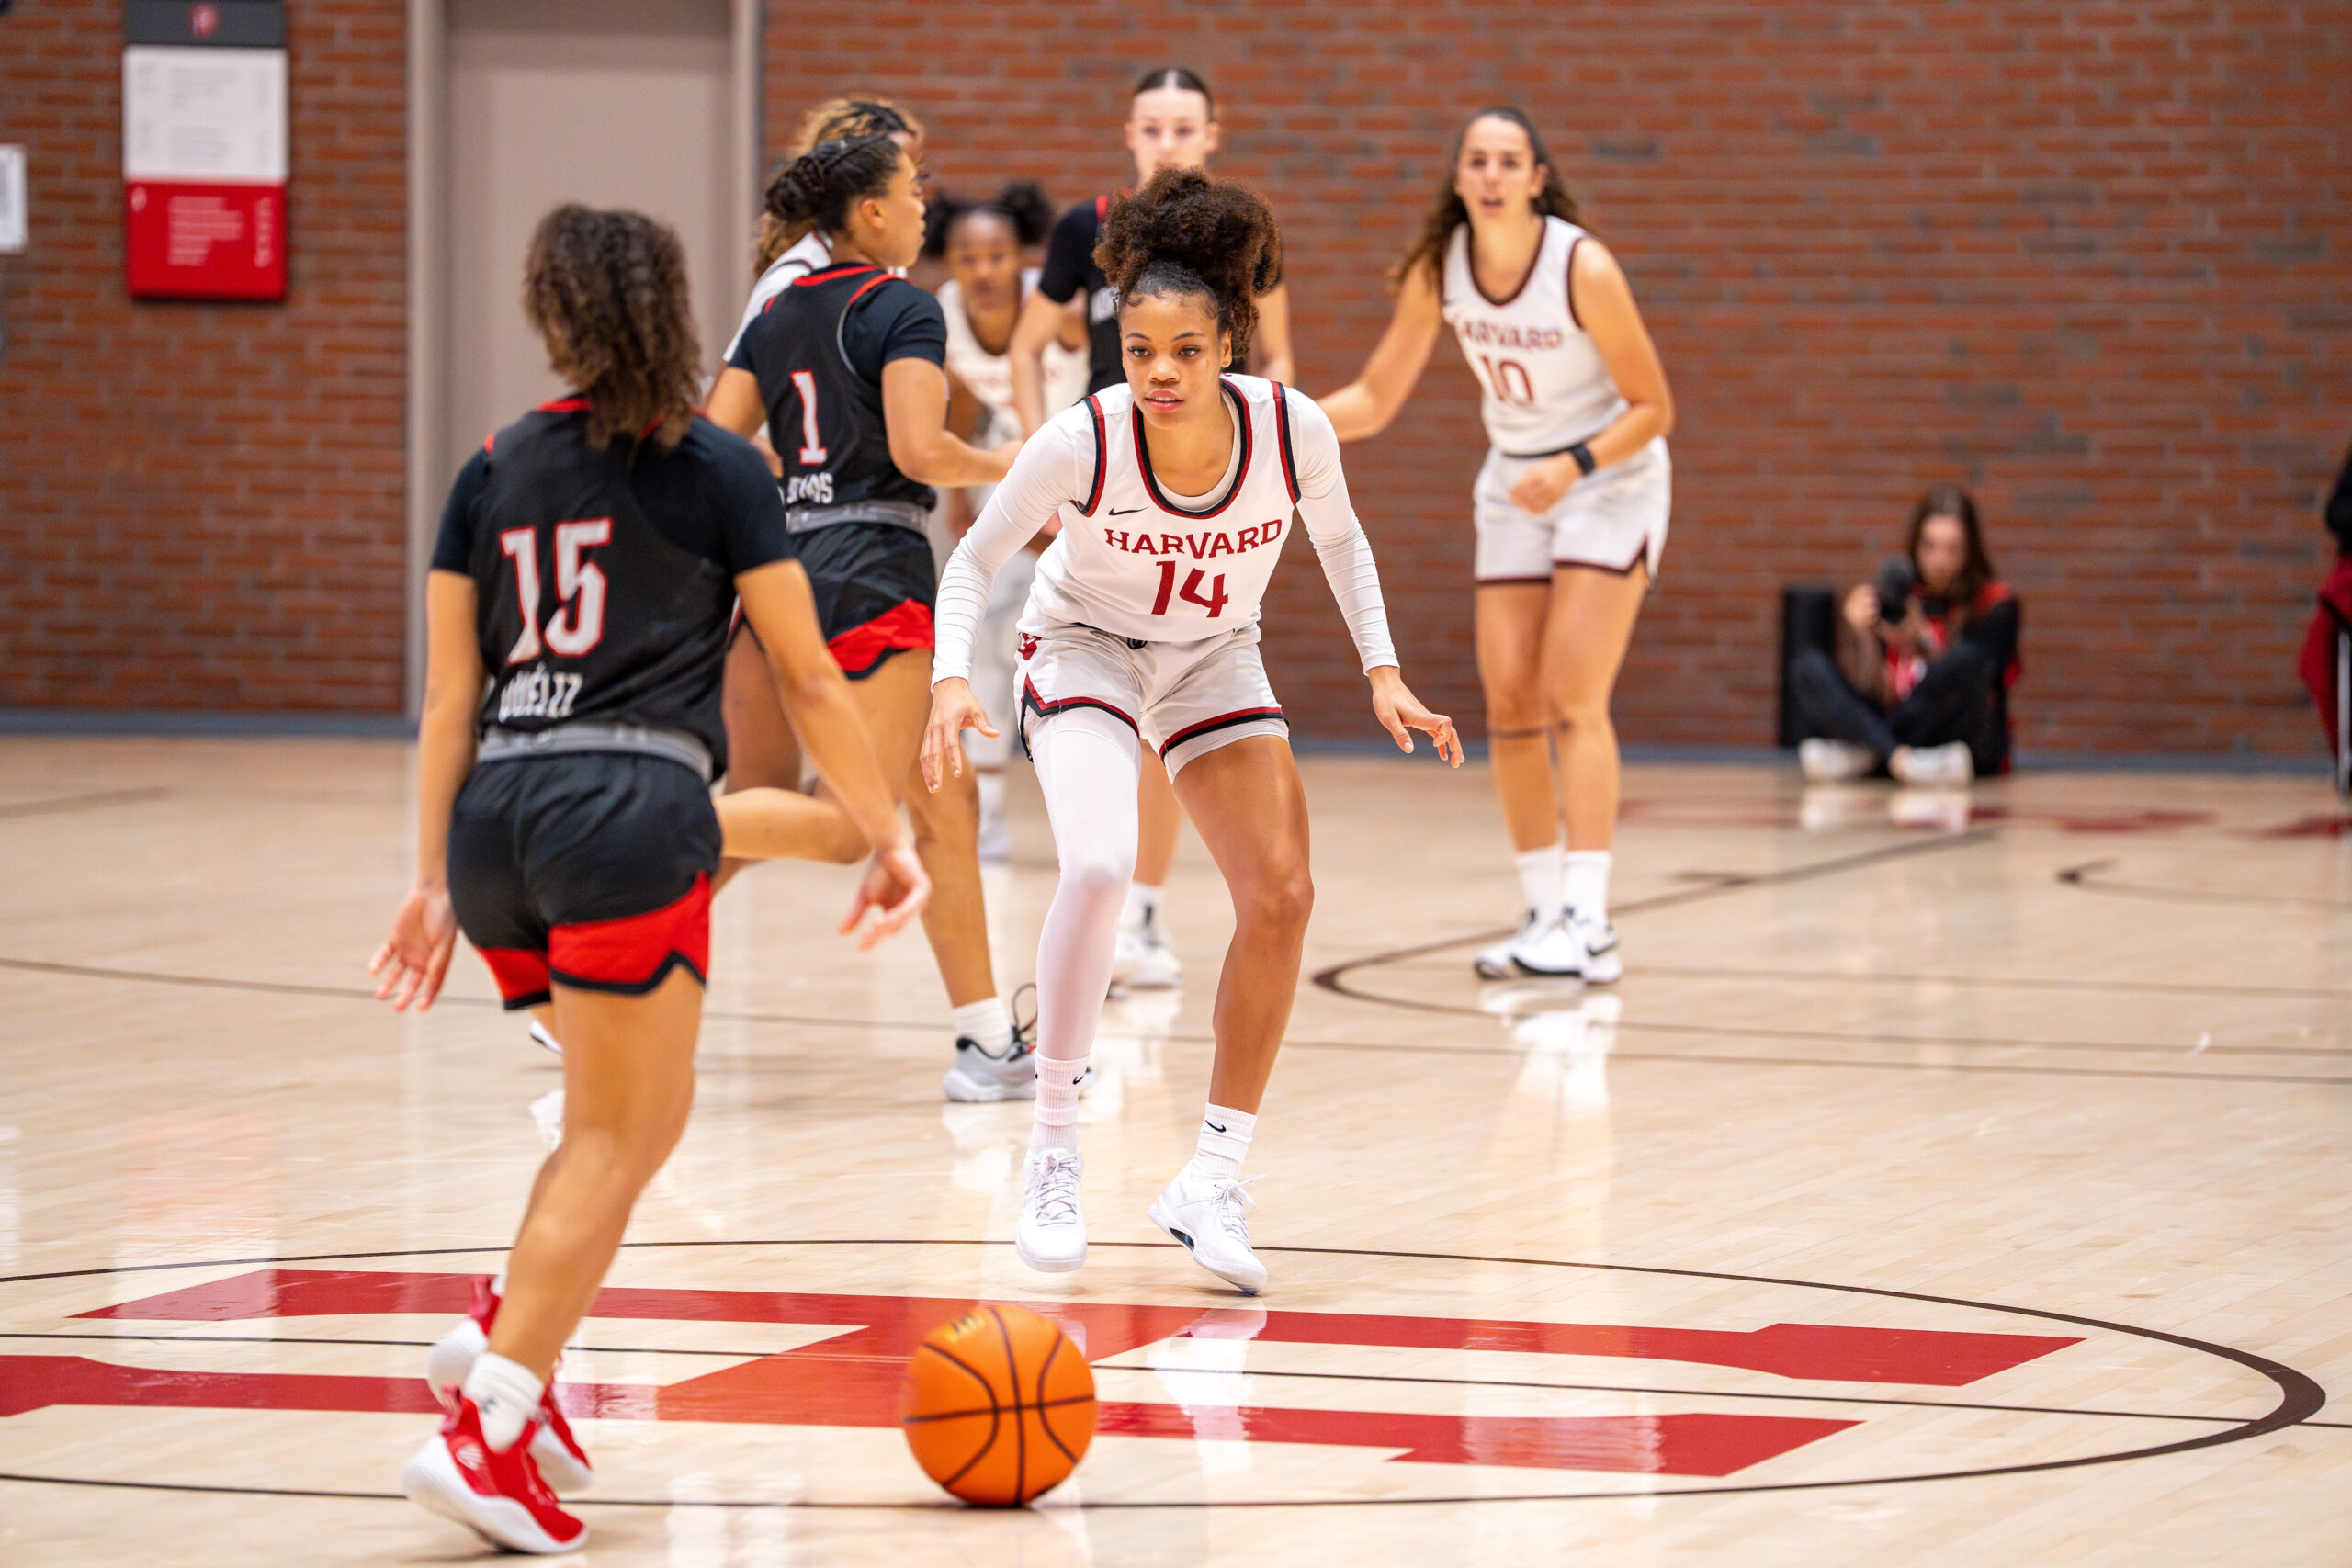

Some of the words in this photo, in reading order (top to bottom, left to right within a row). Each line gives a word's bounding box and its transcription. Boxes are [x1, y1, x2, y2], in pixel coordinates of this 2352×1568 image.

[1480, 355, 1534, 405] 10
[790, 369, 828, 465] 1
[1103, 519, 1283, 559] HARVARD
[499, 515, 614, 667] 15
[1151, 560, 1229, 618] 14
